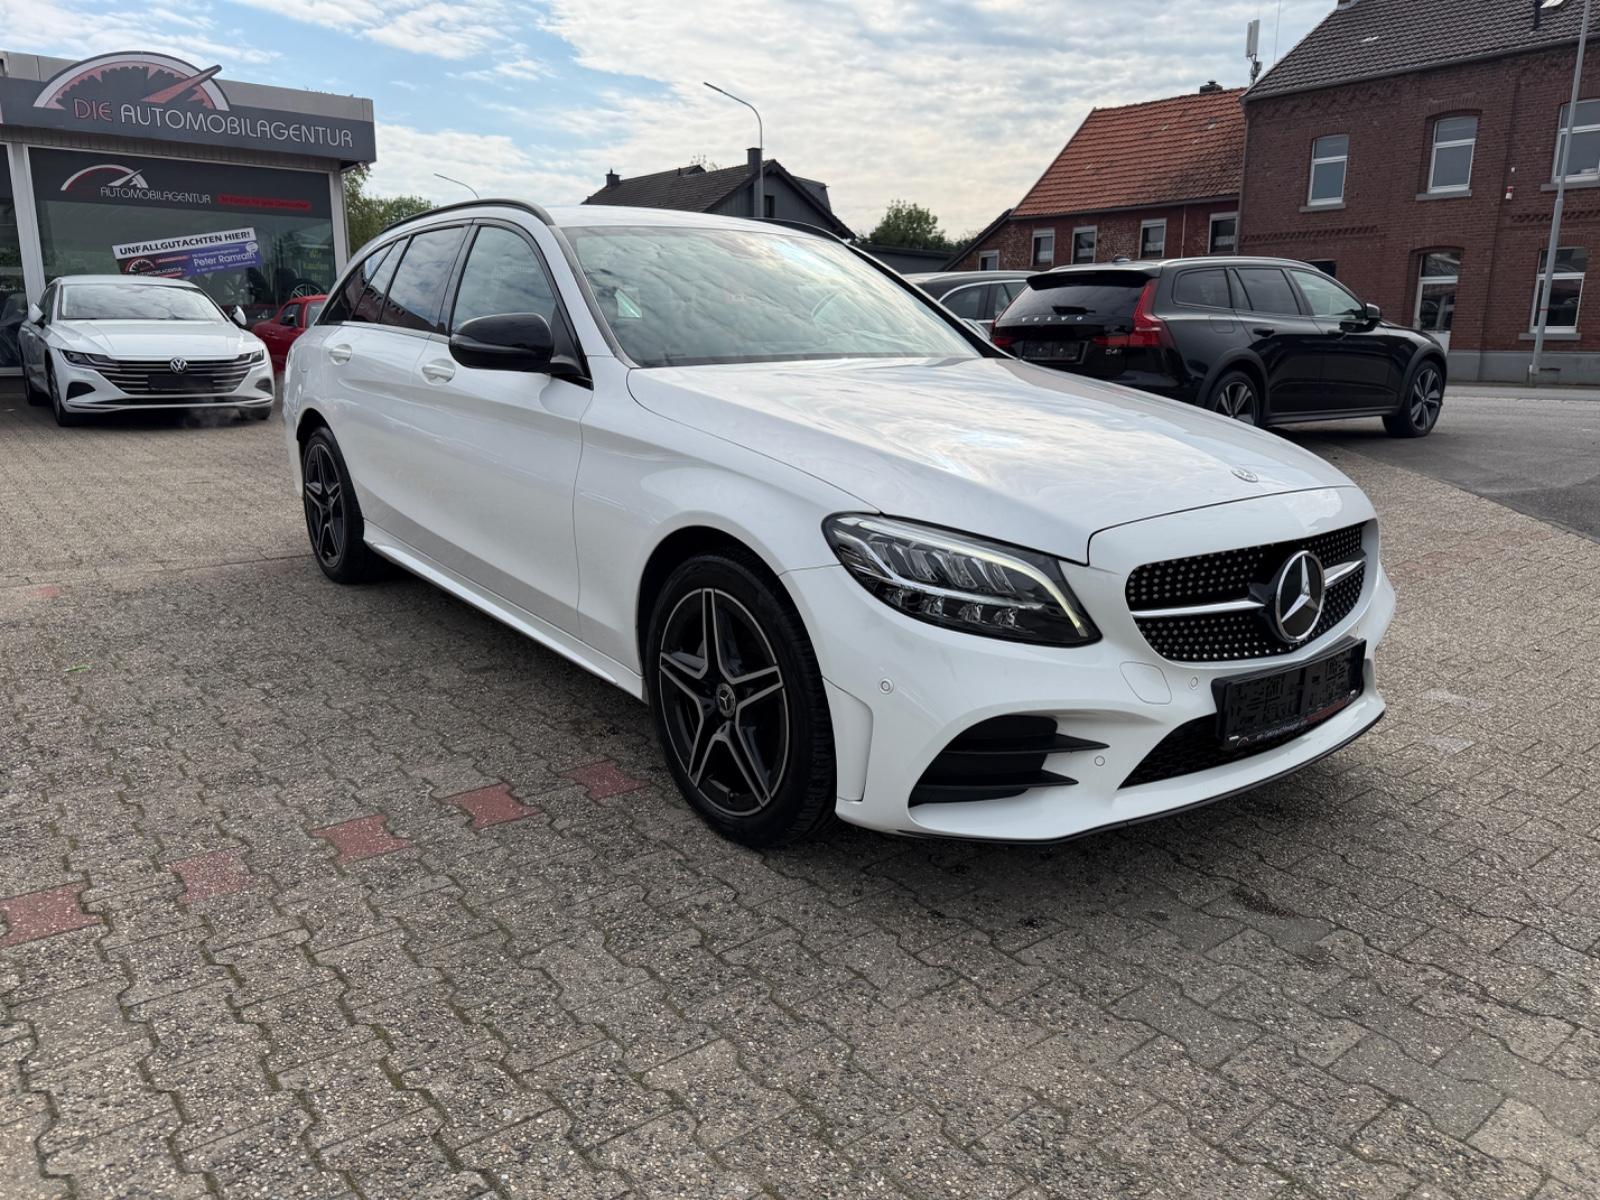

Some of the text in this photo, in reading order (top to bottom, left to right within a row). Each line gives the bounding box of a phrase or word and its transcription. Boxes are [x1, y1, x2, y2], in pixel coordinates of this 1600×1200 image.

[74, 98, 353, 148] DIE AUTOMOBILAGENTUR
[100, 186, 211, 204] AUTOMOBILAGENTUR
[119, 237, 223, 255] UNFALLGUTACHTEN
[224, 231, 251, 242] HIER!
[193, 257, 217, 267] Peter
